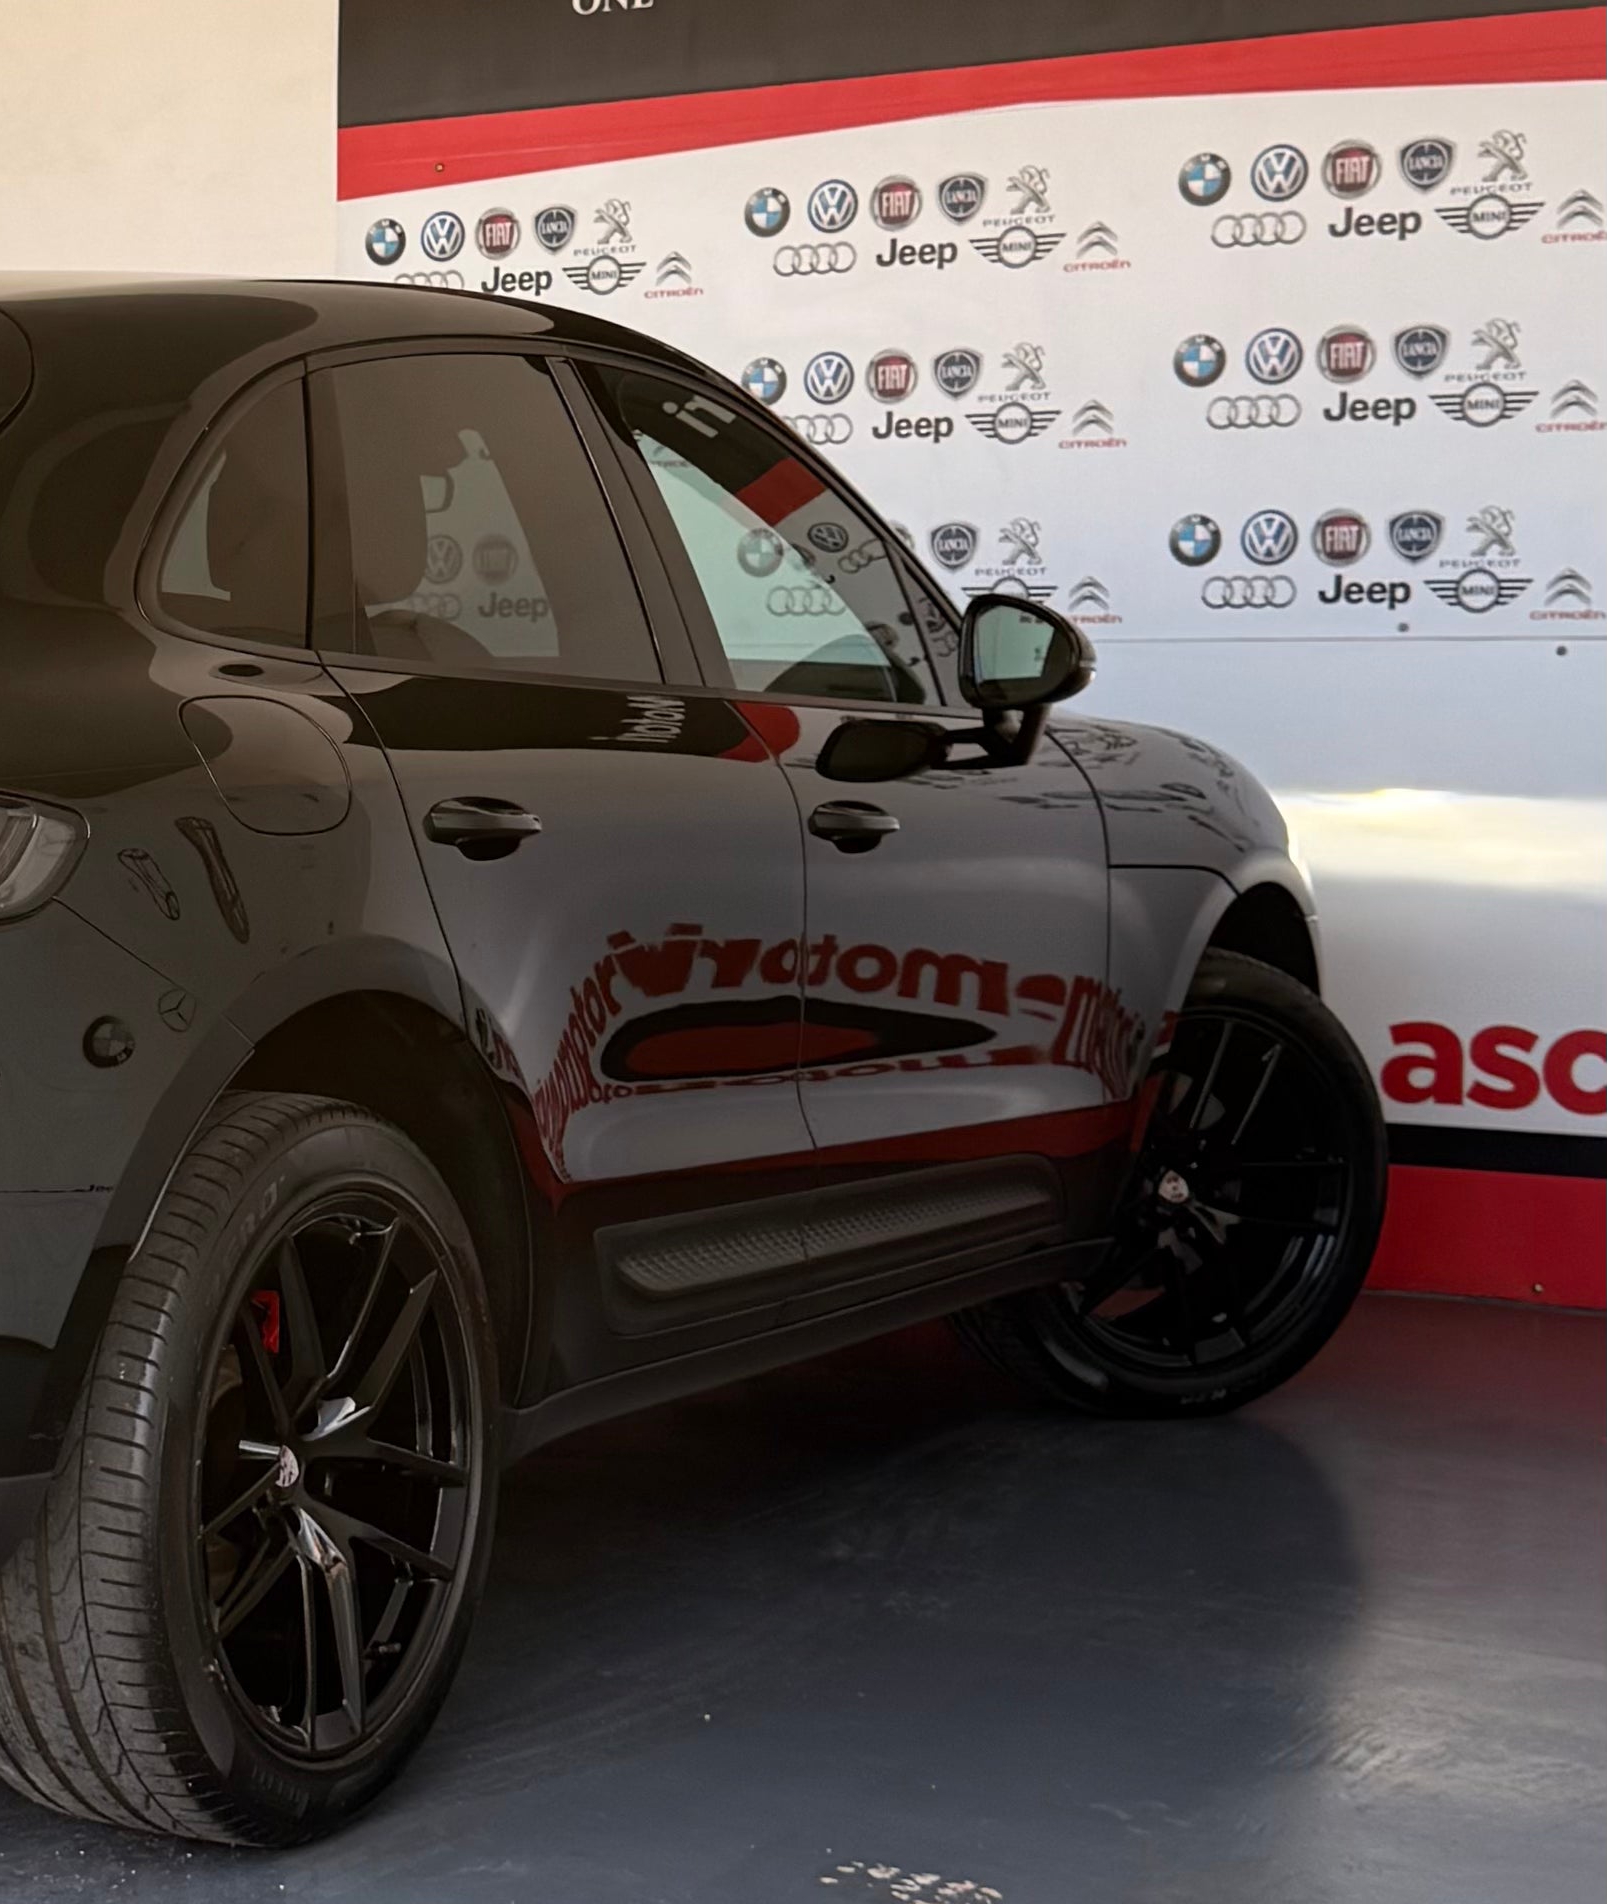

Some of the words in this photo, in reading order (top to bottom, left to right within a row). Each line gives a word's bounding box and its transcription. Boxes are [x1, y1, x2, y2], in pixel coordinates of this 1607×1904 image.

[1328, 206, 1422, 240] Jeep
[876, 238, 958, 269] Jeep
[481, 266, 553, 296] Jeep
[1323, 392, 1417, 426] Jeep
[872, 411, 954, 443] Jeep
[477, 592, 549, 623] Jeep
[1318, 574, 1412, 610] Jeep
